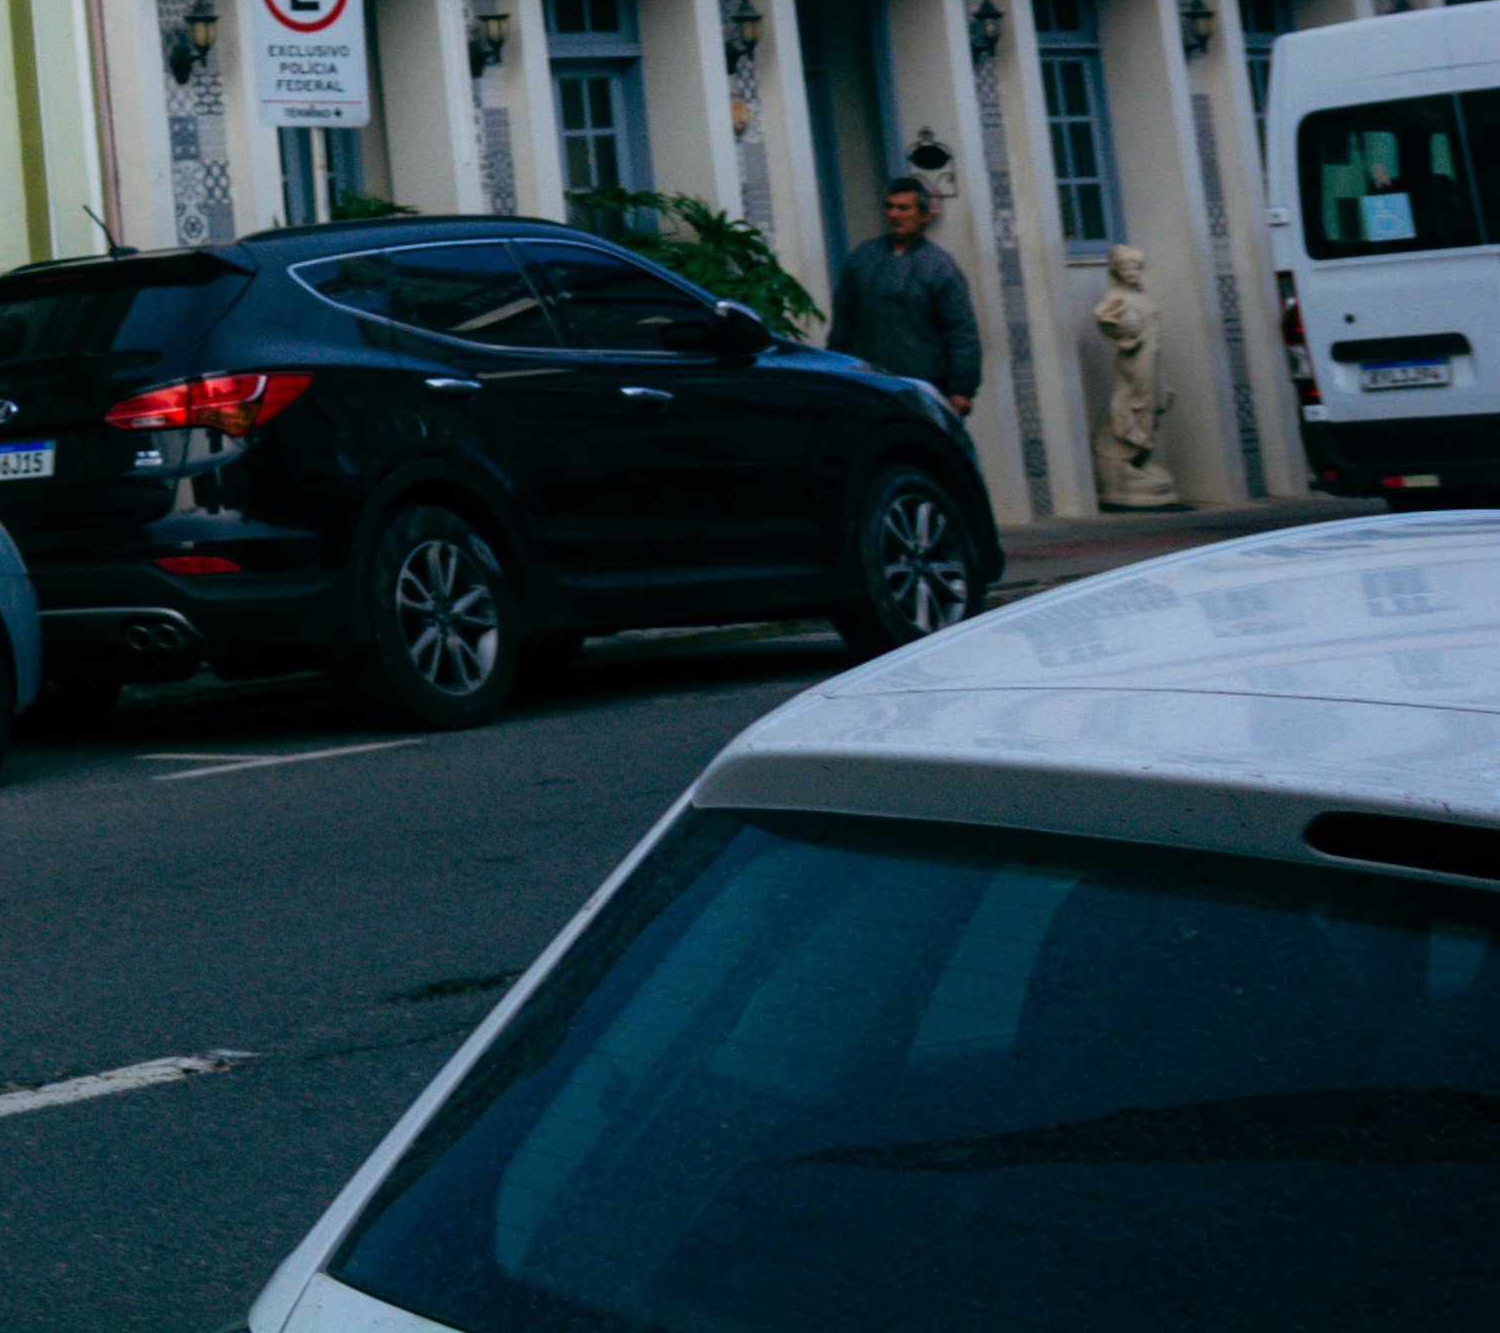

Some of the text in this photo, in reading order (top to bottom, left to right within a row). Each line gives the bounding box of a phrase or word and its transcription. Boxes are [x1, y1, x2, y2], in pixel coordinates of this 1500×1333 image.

[267, 44, 350, 58] EXCLUSIVO
[279, 60, 338, 75] POLÍCIA
[275, 78, 345, 93] FEDERAL
